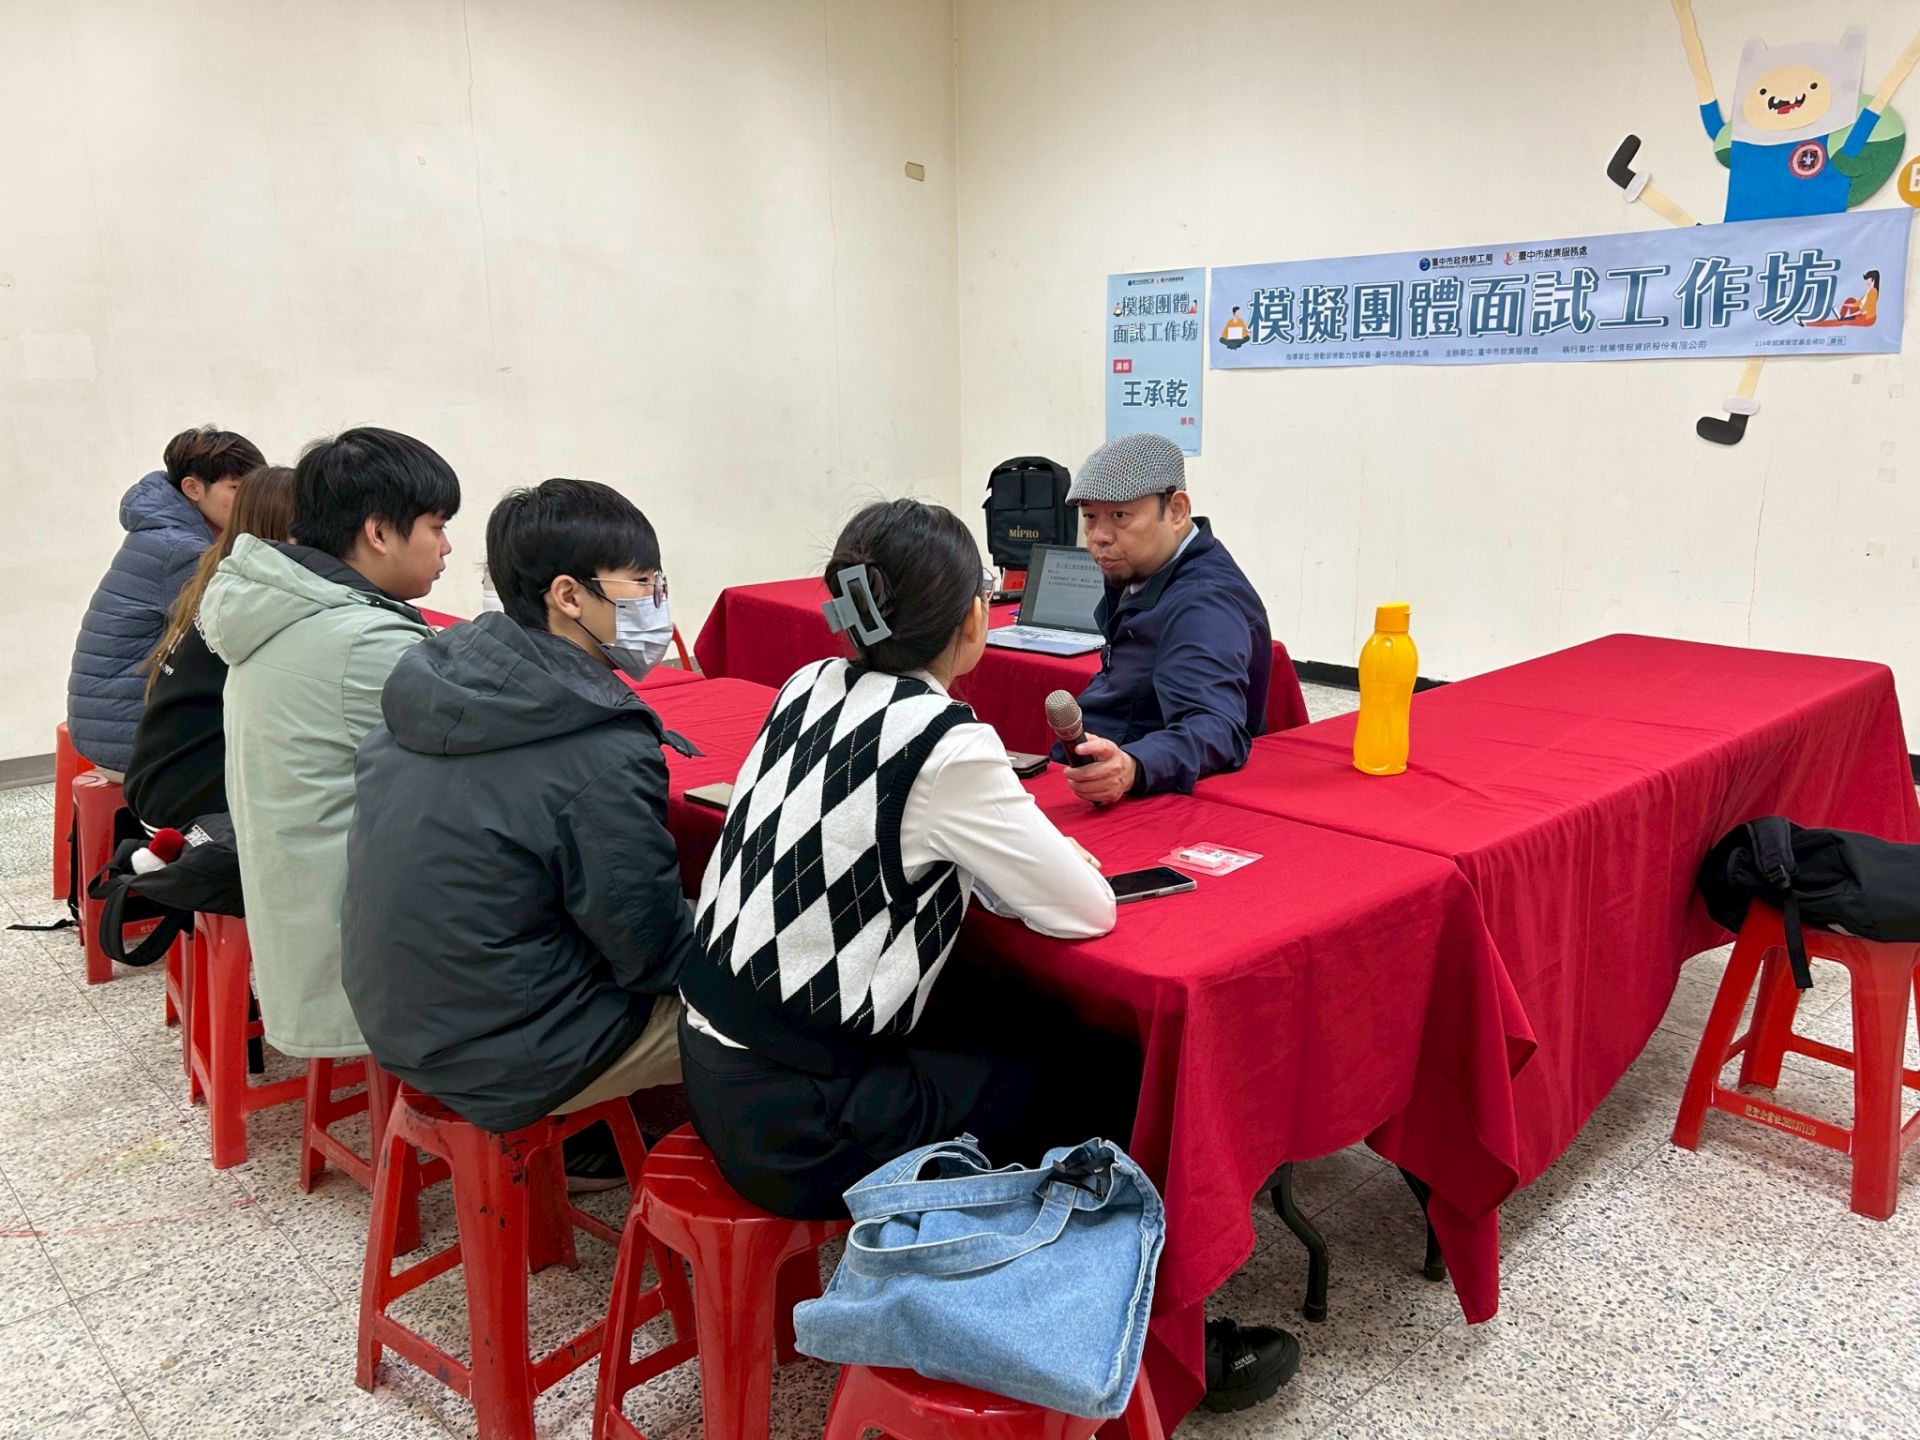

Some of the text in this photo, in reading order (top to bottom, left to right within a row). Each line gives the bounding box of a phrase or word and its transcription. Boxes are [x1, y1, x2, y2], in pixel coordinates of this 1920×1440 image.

[1432, 254, 1493, 266] 臺中市政府勞工局
[1519, 246, 1587, 261] 臺中市就業服務處
[1121, 291, 1190, 317] 模擬團體
[1248, 249, 1840, 345] 模擬團體面試工作坊
[1113, 320, 1198, 343] 面試工作坊
[1122, 379, 1189, 407] 王承乾
